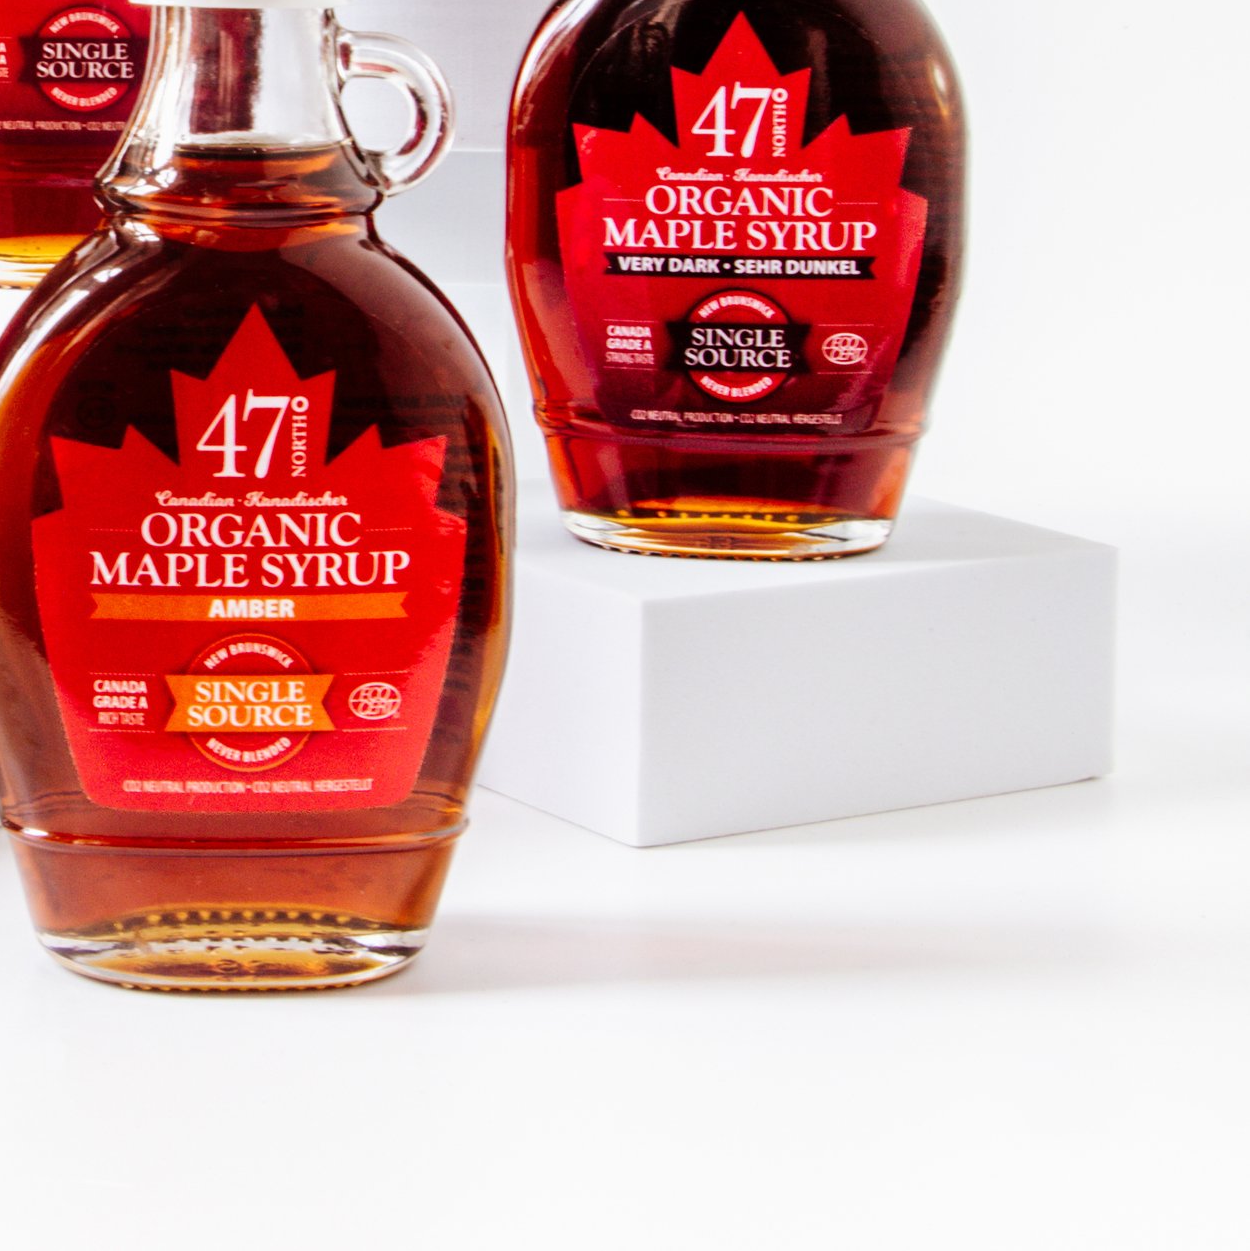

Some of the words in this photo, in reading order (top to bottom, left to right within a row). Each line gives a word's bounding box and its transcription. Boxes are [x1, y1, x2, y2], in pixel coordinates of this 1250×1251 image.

[42, 43, 129, 60] SINGLE
[36, 61, 134, 78] SOURCE
[772, 104, 786, 157] NORTH
[656, 166, 723, 181] Canadian
[733, 168, 823, 183] Kanadischer
[645, 185, 833, 217] ORGANIC
[602, 217, 737, 250] MAPLE
[746, 220, 877, 252] SYRUP
[617, 256, 664, 272] VERY
[668, 257, 720, 273] DARK
[733, 258, 782, 274] SEHR
[785, 259, 861, 275] DUNKEL
[698, 300, 720, 318] NEW
[606, 325, 652, 338] CANADA
[691, 328, 786, 348] SINGLE
[606, 338, 642, 350] GRADE
[643, 338, 652, 350] A
[685, 348, 791, 368] SOURCE
[700, 376, 729, 396] NEVER
[291, 415, 307, 477] NORTH
[155, 490, 234, 506] Canadian
[244, 491, 348, 507] Kanadischer
[141, 512, 362, 547] ORGANIC
[89, 551, 249, 587] MAPLE
[261, 551, 410, 587] SYRUP
[208, 599, 295, 618] AMBER
[204, 648, 228, 669] NEW
[228, 642, 294, 668] BRUNSWICK
[93, 680, 147, 693] CANADA
[195, 681, 305, 703] SINGLE
[93, 696, 136, 709] GRADE
[138, 696, 148, 709] A
[187, 705, 313, 727] SOURCE
[206, 737, 240, 761] NEVER
[242, 736, 291, 762] BLENDED
